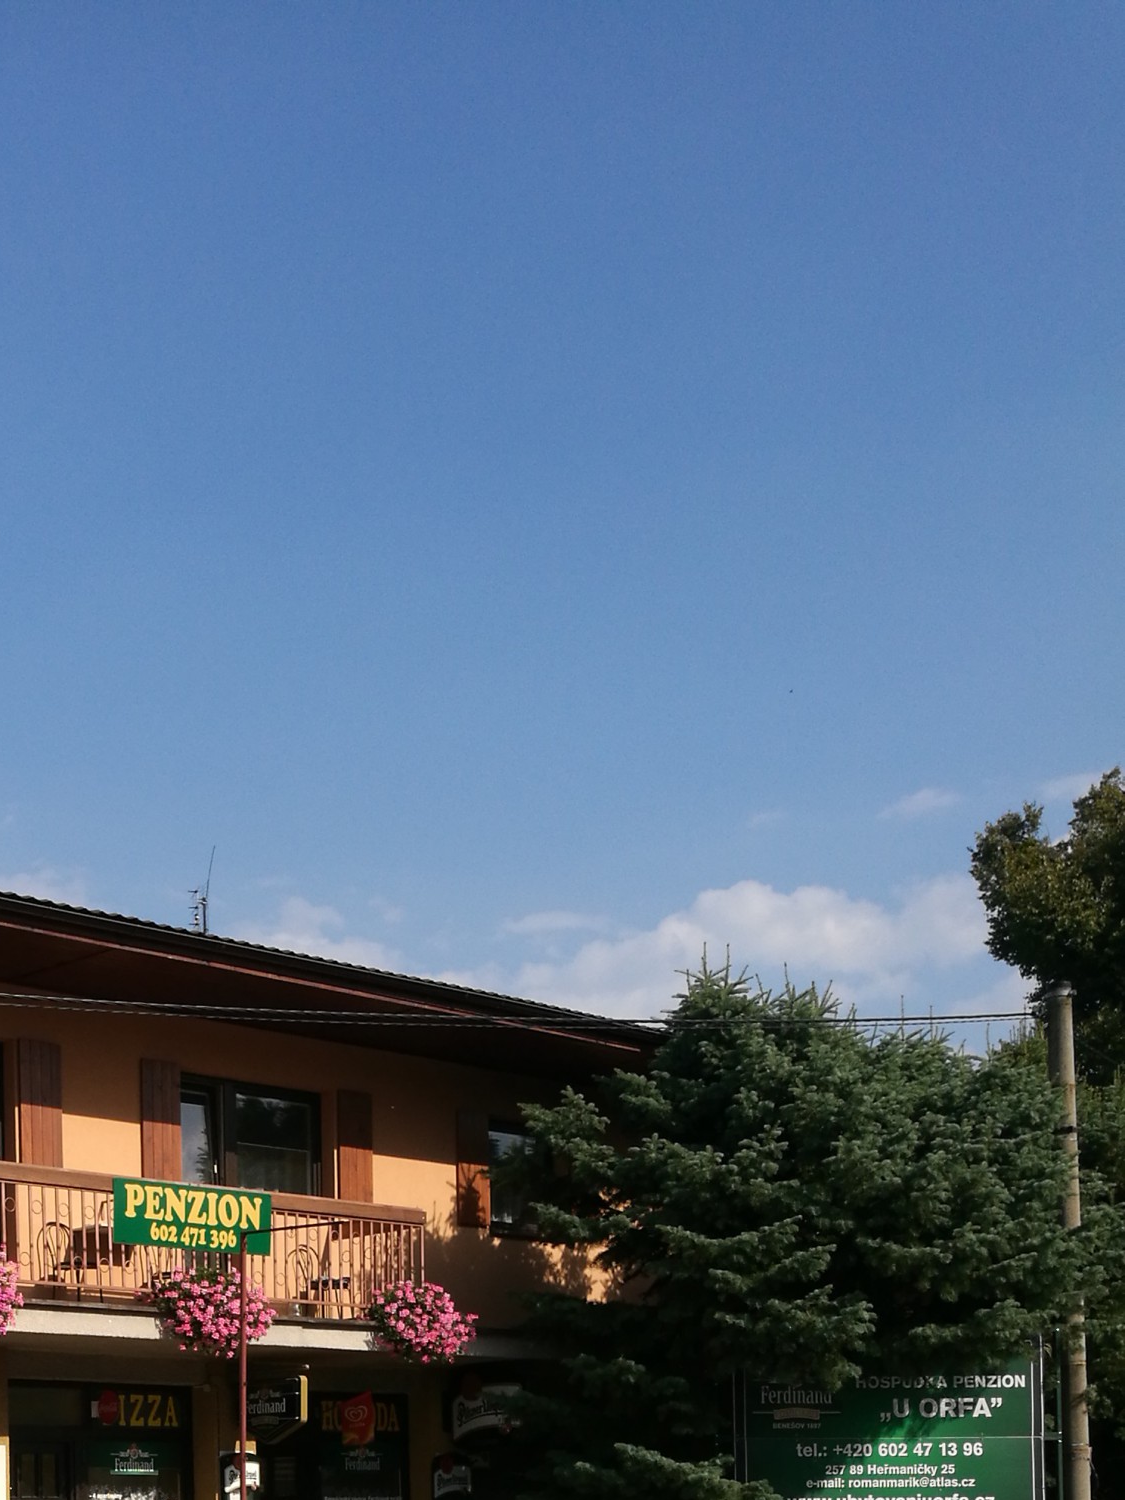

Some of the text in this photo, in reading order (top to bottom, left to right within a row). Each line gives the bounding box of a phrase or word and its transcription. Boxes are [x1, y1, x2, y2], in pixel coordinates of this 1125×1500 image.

[124, 1183, 263, 1231] PENZION
[150, 1222, 237, 1250] 602 471 396
[953, 1374, 1026, 1388] PENZION
[118, 1394, 178, 1427] IZZA
[796, 1442, 984, 1457] tel.: +420 602 47 13 96
[115, 1457, 154, 1472] Ferdinand
[825, 1463, 956, 1476] 257 89 Heřmaničky 25
[806, 1476, 976, 1488] e-mail: romanmarik@atlas.cz
